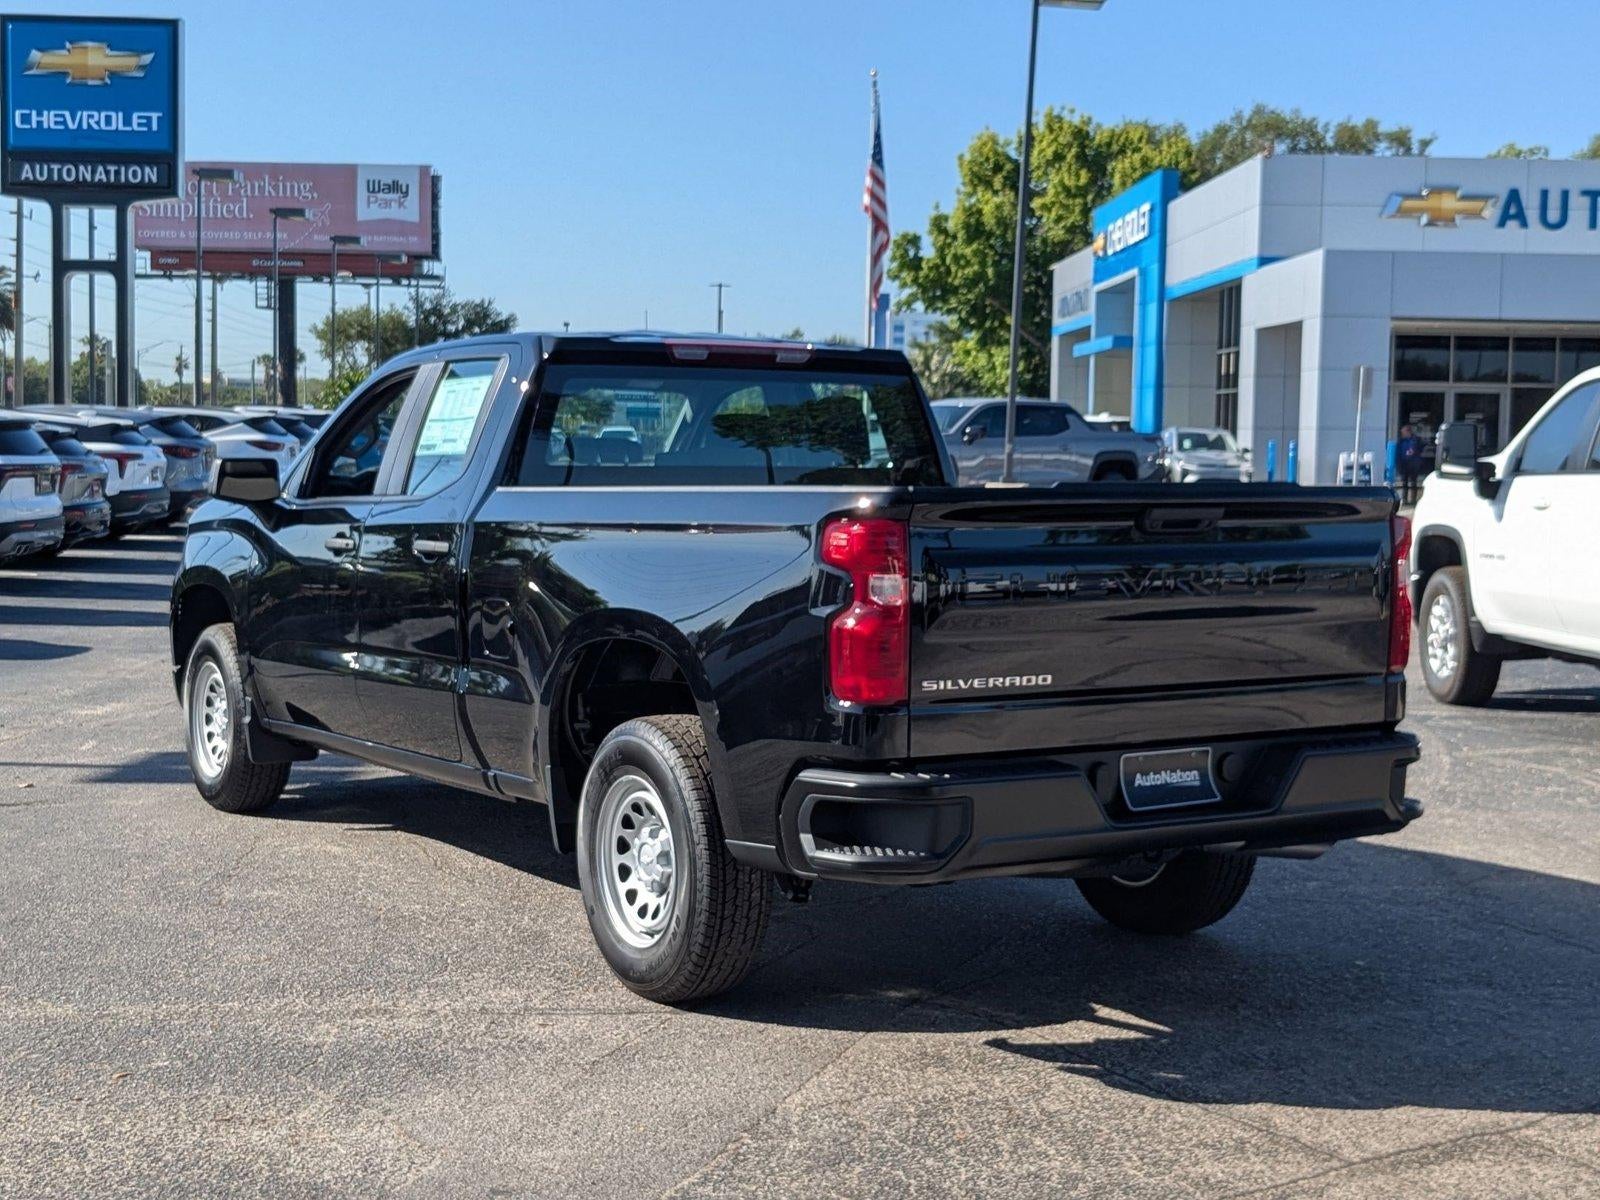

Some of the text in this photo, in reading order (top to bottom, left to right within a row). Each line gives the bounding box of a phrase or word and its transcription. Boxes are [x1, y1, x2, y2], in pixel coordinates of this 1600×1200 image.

[15, 109, 162, 132] CHEVROLET
[21, 163, 158, 183] AUTONATION
[366, 179, 410, 199] Wally
[366, 195, 408, 209] Park
[1496, 188, 1600, 230] AUT
[137, 230, 177, 238] COVERED
[921, 674, 1053, 691] SILVERADO
[1134, 769, 1200, 787] AutoNation
